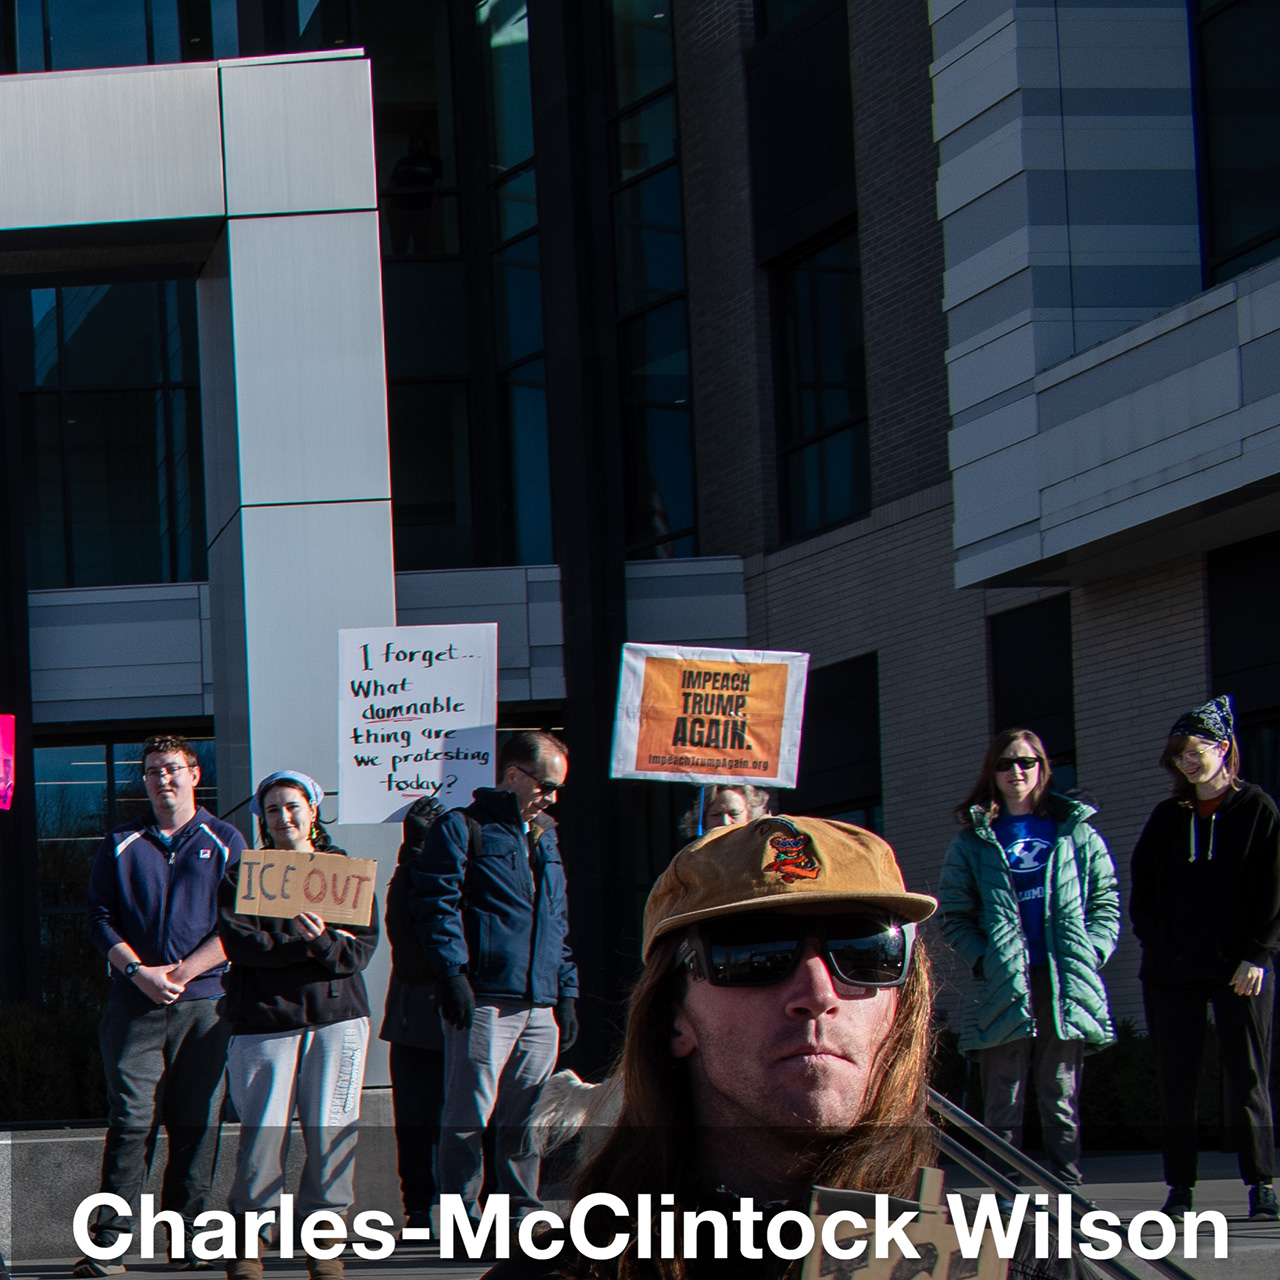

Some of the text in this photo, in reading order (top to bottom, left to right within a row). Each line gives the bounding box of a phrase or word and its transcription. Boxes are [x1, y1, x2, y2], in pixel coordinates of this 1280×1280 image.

[359, 643, 374, 671] I
[350, 678, 413, 699] What
[681, 670, 751, 692] IMPEACH
[362, 696, 465, 720] damnable
[350, 727, 457, 748] thing are
[672, 717, 753, 750] AGAIN.
[392, 748, 490, 772] protesting
[379, 773, 458, 797] today?
[241, 861, 371, 909] ICE OUT
